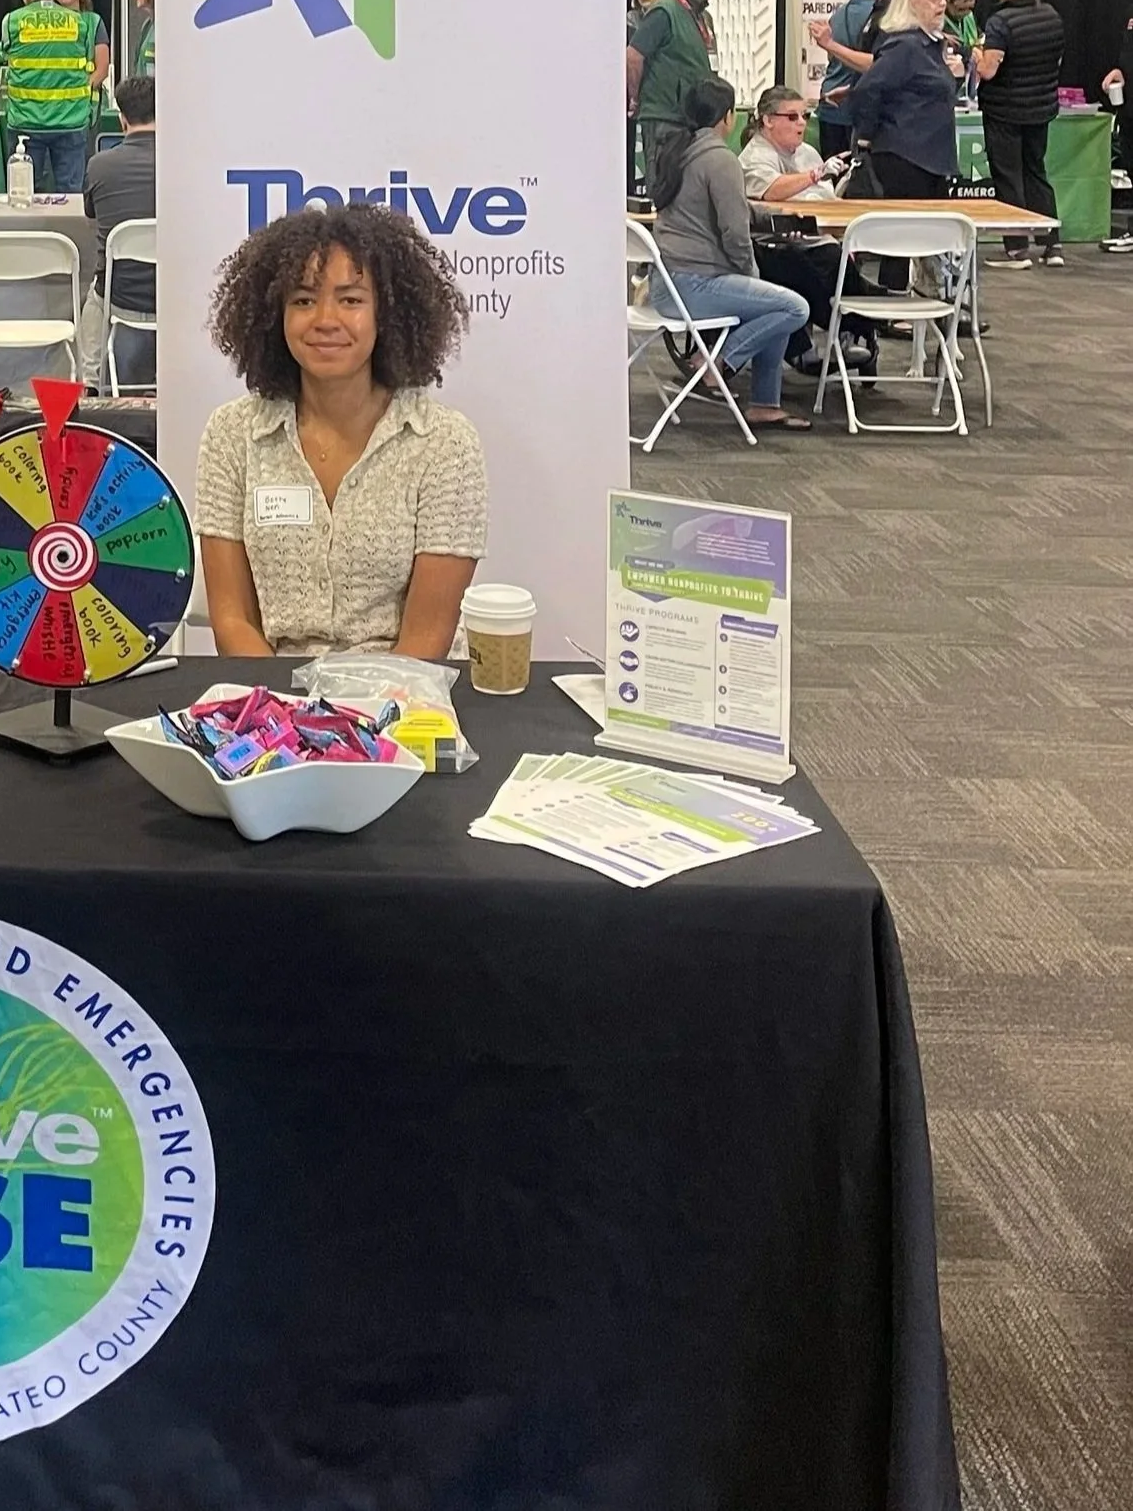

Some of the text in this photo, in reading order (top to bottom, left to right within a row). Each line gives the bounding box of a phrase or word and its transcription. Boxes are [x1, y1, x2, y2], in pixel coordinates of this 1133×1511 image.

[13, 445, 47, 494] coloring
[59, 467, 77, 509] candy
[96, 506, 122, 531] book
[630, 515, 662, 528] Thrive
[106, 526, 167, 555] popcorn
[627, 570, 666, 585] EMPOWER
[668, 576, 718, 595] NONPROFITS
[79, 607, 103, 648] book
[92, 597, 131, 658] coloring
[648, 608, 699, 624] PROGRAMS
[53, 974, 196, 1259] EMERGENCIES
[78, 1280, 171, 1376] COUNTY
